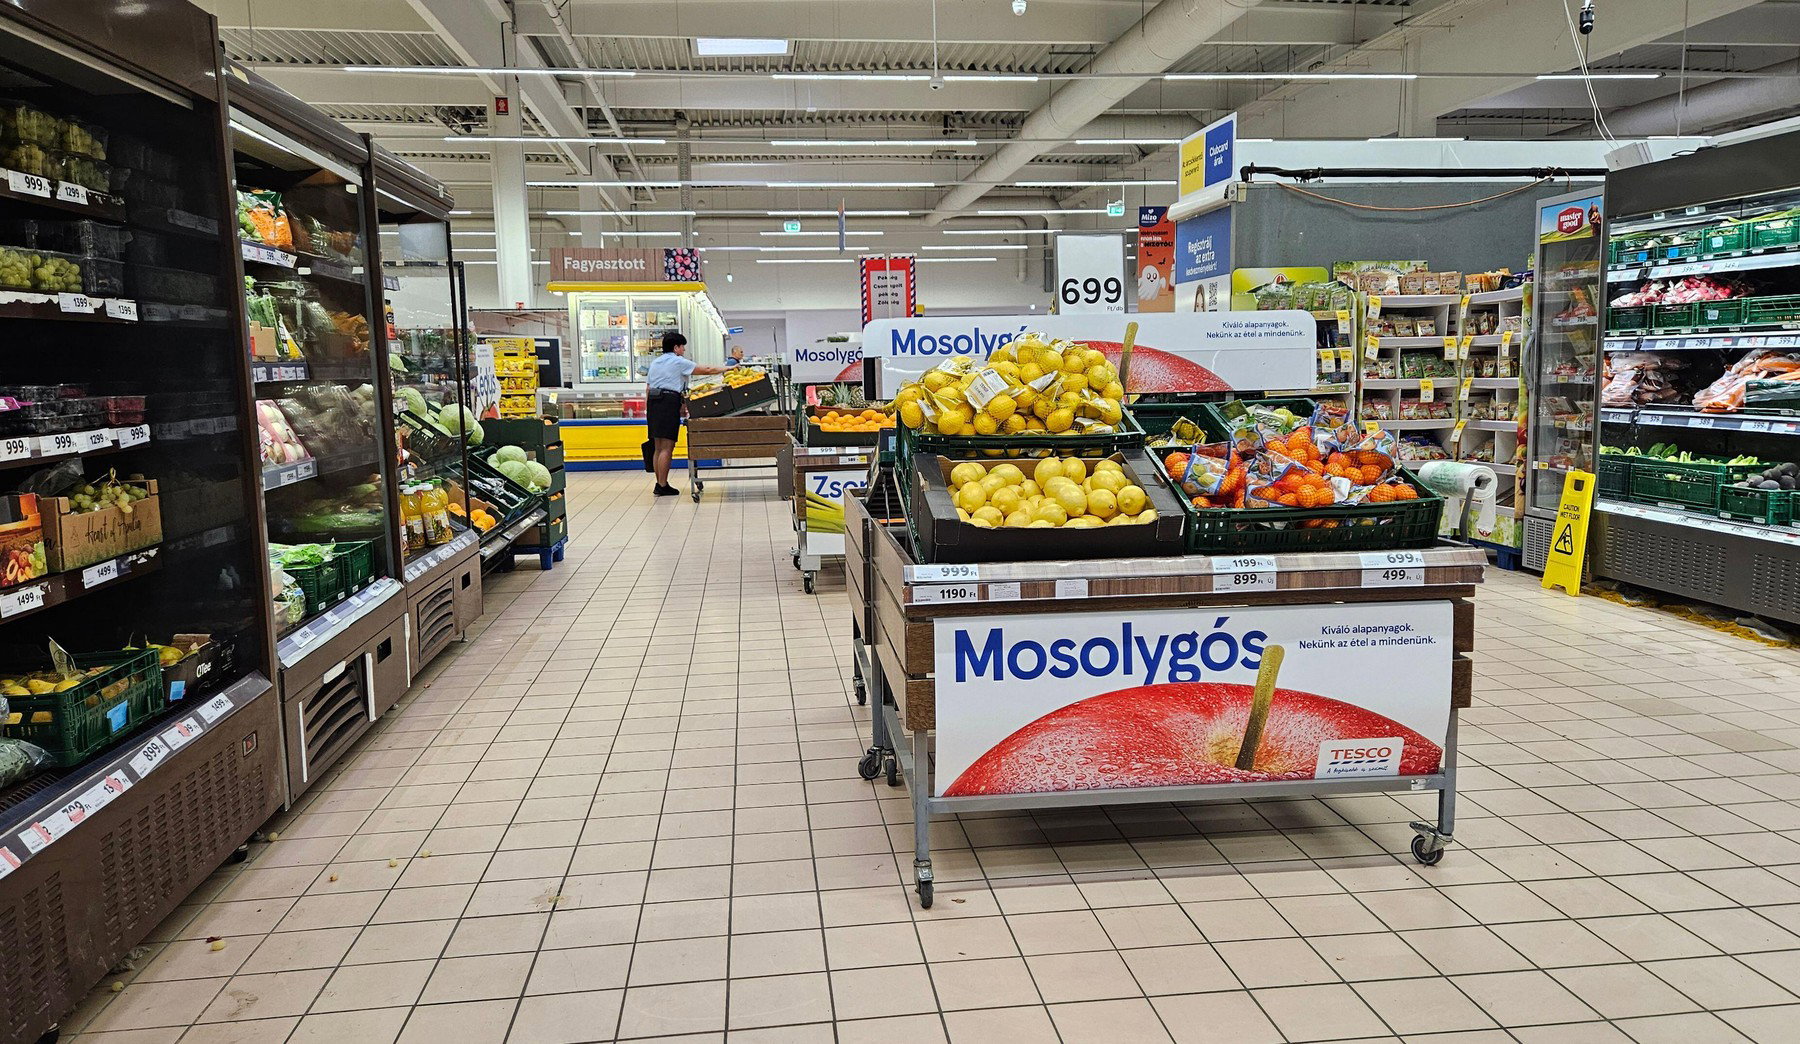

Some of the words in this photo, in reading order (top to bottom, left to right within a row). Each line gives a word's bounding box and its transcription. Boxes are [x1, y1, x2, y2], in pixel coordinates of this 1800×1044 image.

[1209, 140, 1229, 157] Clubcard
[1213, 154, 1224, 167] árak
[24, 175, 42, 191] 999
[64, 186, 80, 198] 1299
[1560, 211, 1582, 222] master
[1562, 219, 1578, 230] good
[1187, 235, 1212, 255] Regisztrálj
[1195, 255, 1201, 264] az
[1202, 250, 1215, 263] extra
[564, 256, 646, 272] Fagyasztott
[1062, 277, 1122, 305] 699
[73, 298, 88, 308] 1399
[118, 304, 132, 315] 1399
[1222, 320, 1243, 329] Kiváló
[1244, 320, 1289, 329] alapanyagok.
[891, 326, 1028, 362] Mosolyg
[90, 433, 104, 445] 1299
[130, 427, 144, 440] 999
[6, 440, 24, 454] 999
[55, 435, 72, 449] 999
[1563, 504, 1580, 512] CAUTION
[1232, 558, 1257, 568] 1199
[1387, 552, 1414, 564] 699
[97, 566, 112, 578] 1499
[940, 566, 970, 577] 999
[1382, 570, 1406, 581] 499
[1234, 574, 1257, 585] 899
[17, 592, 34, 606] 1499
[940, 588, 966, 599] 1190
[1321, 625, 1350, 635] Kiváló
[1352, 623, 1414, 634] alapanyagok.
[1299, 640, 1335, 649] Nekünk
[1350, 638, 1369, 647] étel
[1379, 635, 1436, 646] mindenünk.
[954, 616, 1269, 685] Mosolygós
[211, 699, 226, 712] 1499
[142, 742, 161, 762] 899
[1331, 747, 1392, 759] TESCO
